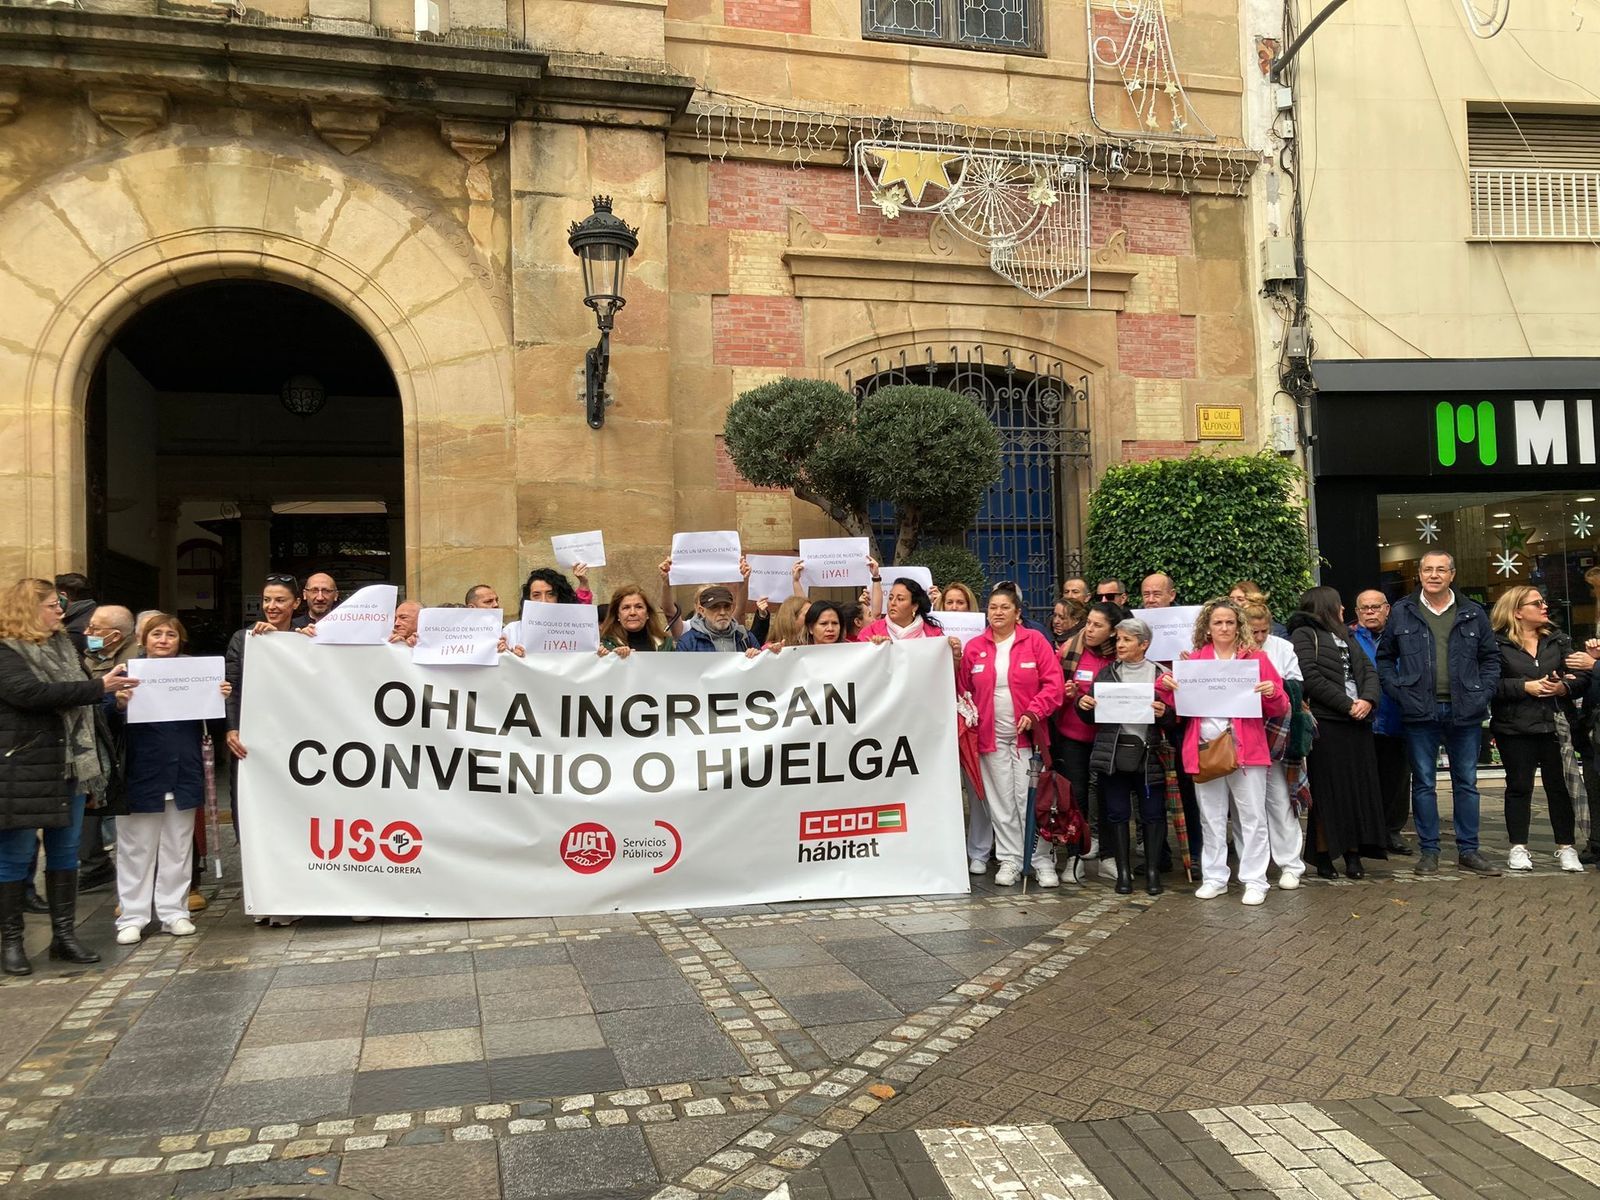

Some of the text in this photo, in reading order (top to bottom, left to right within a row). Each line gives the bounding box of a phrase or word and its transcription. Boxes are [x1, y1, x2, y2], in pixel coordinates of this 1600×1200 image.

[1214, 411, 1231, 420] CALLE
[1202, 421, 1232, 431] ALFONSO
[822, 568, 849, 579] ¡¡YA!!
[441, 644, 474, 655] ¡¡YA!!
[544, 640, 577, 651] ¡¡YA!!
[374, 681, 857, 738] OHLA INGRESAN
[288, 735, 920, 795] CONVENIO O HUELGA
[805, 812, 873, 834] CCOO
[310, 817, 423, 864] USO
[566, 831, 609, 852] UGT
[622, 837, 667, 848] Servicios
[622, 849, 663, 858] Públicos
[798, 838, 880, 863] hábitat
[308, 860, 422, 874] UNIÓN SINDICAL OBRERA
